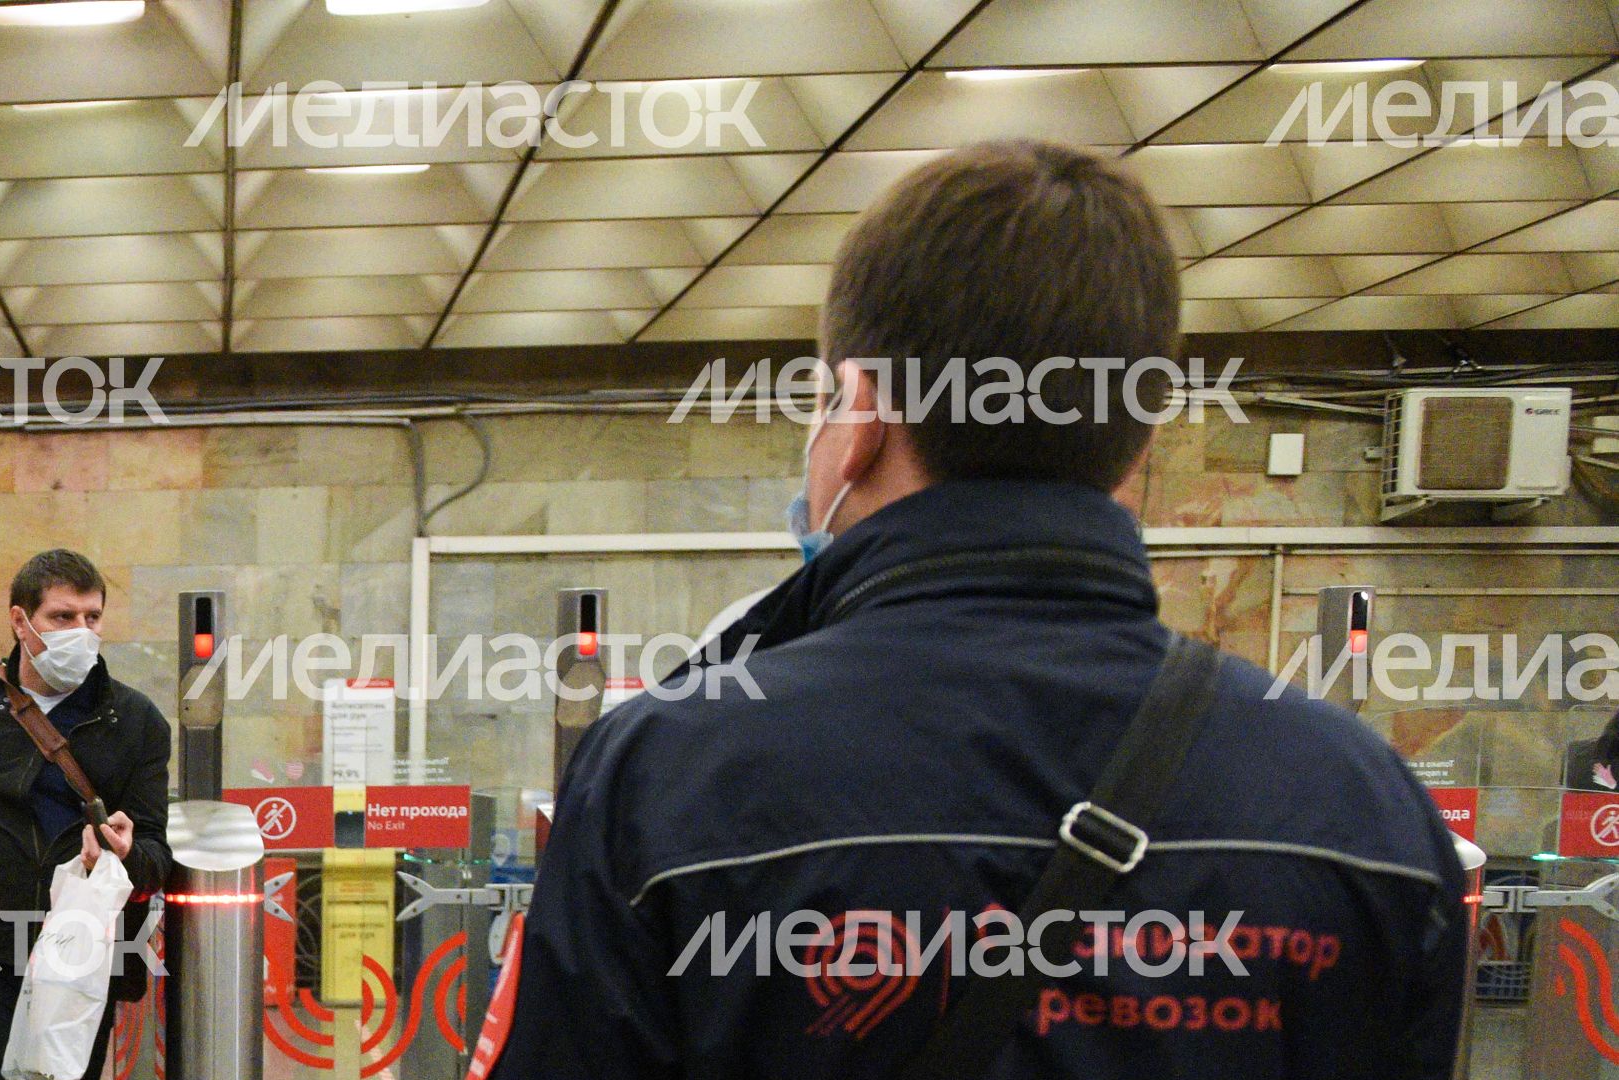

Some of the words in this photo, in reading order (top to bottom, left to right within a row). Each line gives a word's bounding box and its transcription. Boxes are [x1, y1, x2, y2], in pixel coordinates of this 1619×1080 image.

[367, 803, 398, 817] Нет
[400, 805, 468, 819] прохода
[367, 821, 383, 831] No
[385, 821, 406, 831] Exit
[1035, 988, 1285, 1037] ревозок
